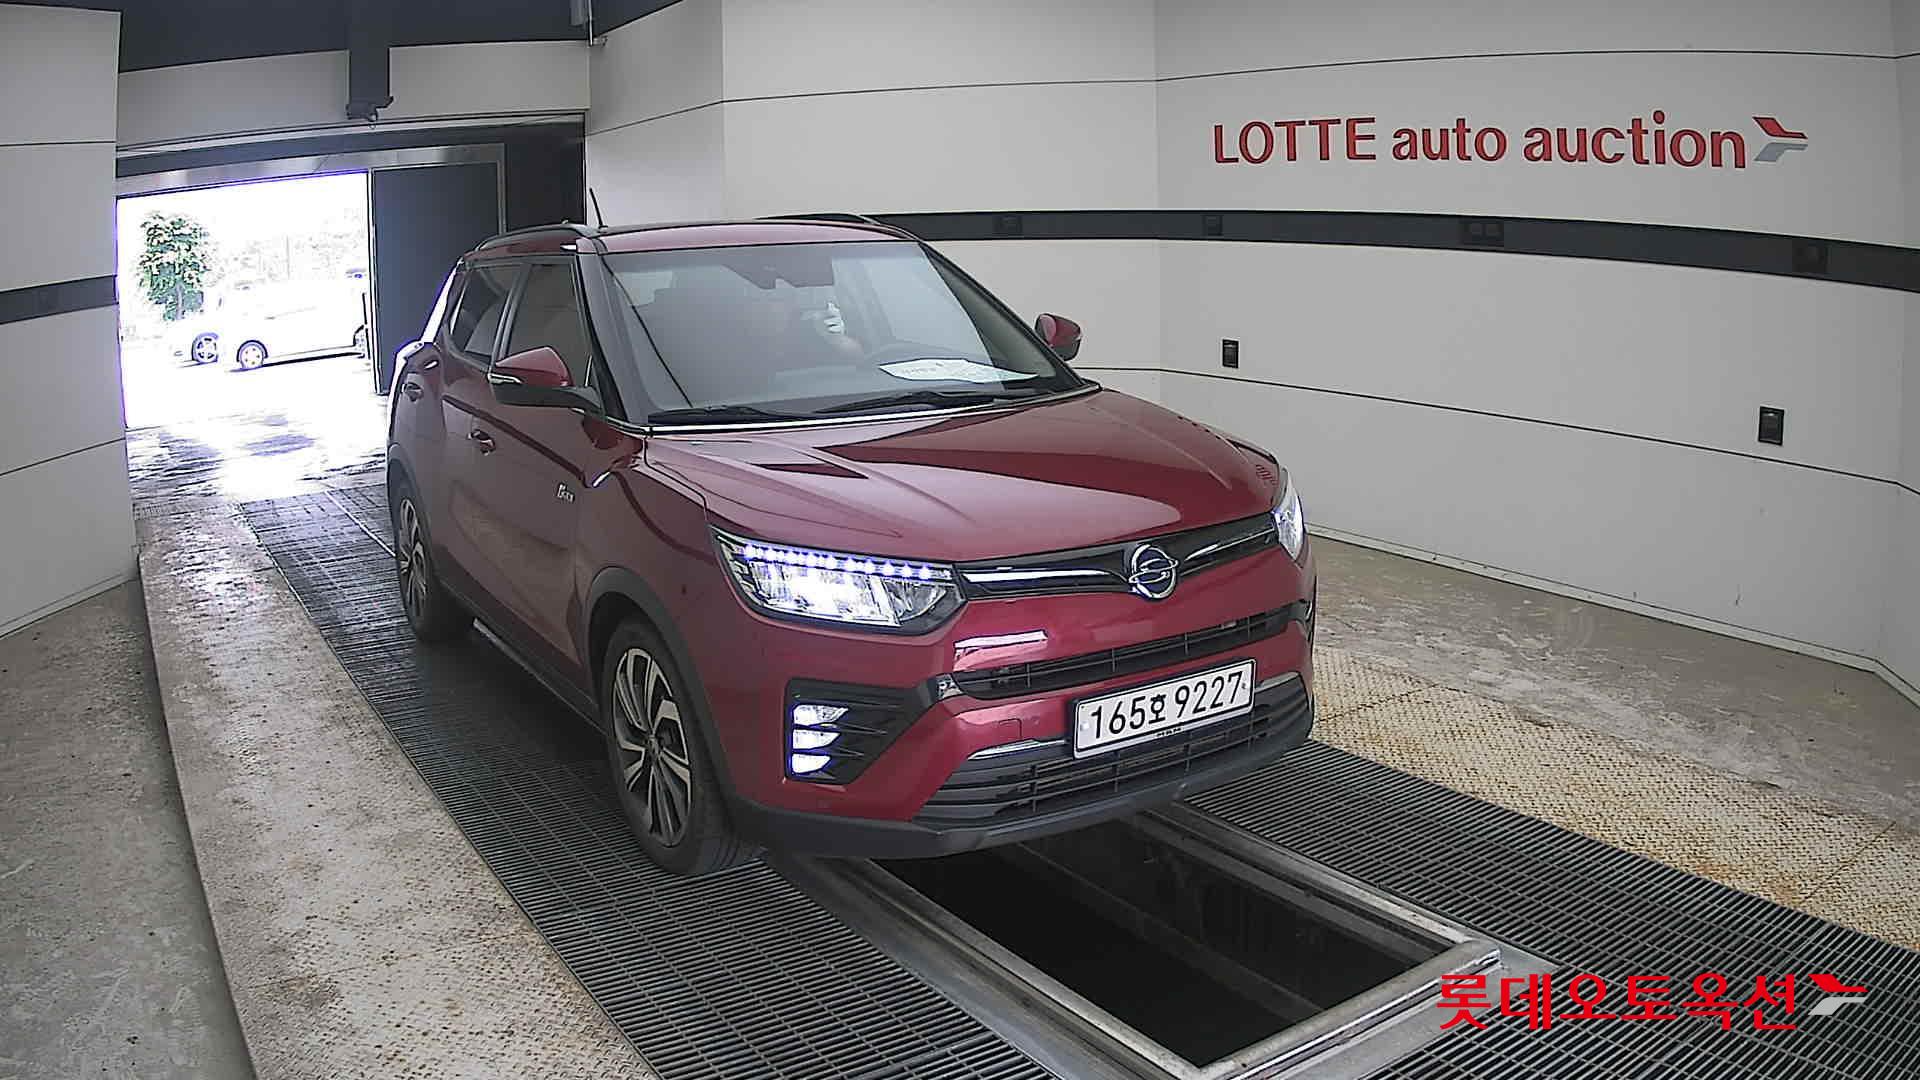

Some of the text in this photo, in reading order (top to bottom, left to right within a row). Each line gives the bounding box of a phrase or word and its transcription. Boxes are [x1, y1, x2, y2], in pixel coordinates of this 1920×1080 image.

[1214, 110, 1747, 169] LOTTE auto auction
[1090, 670, 1243, 739] 165호 9227
